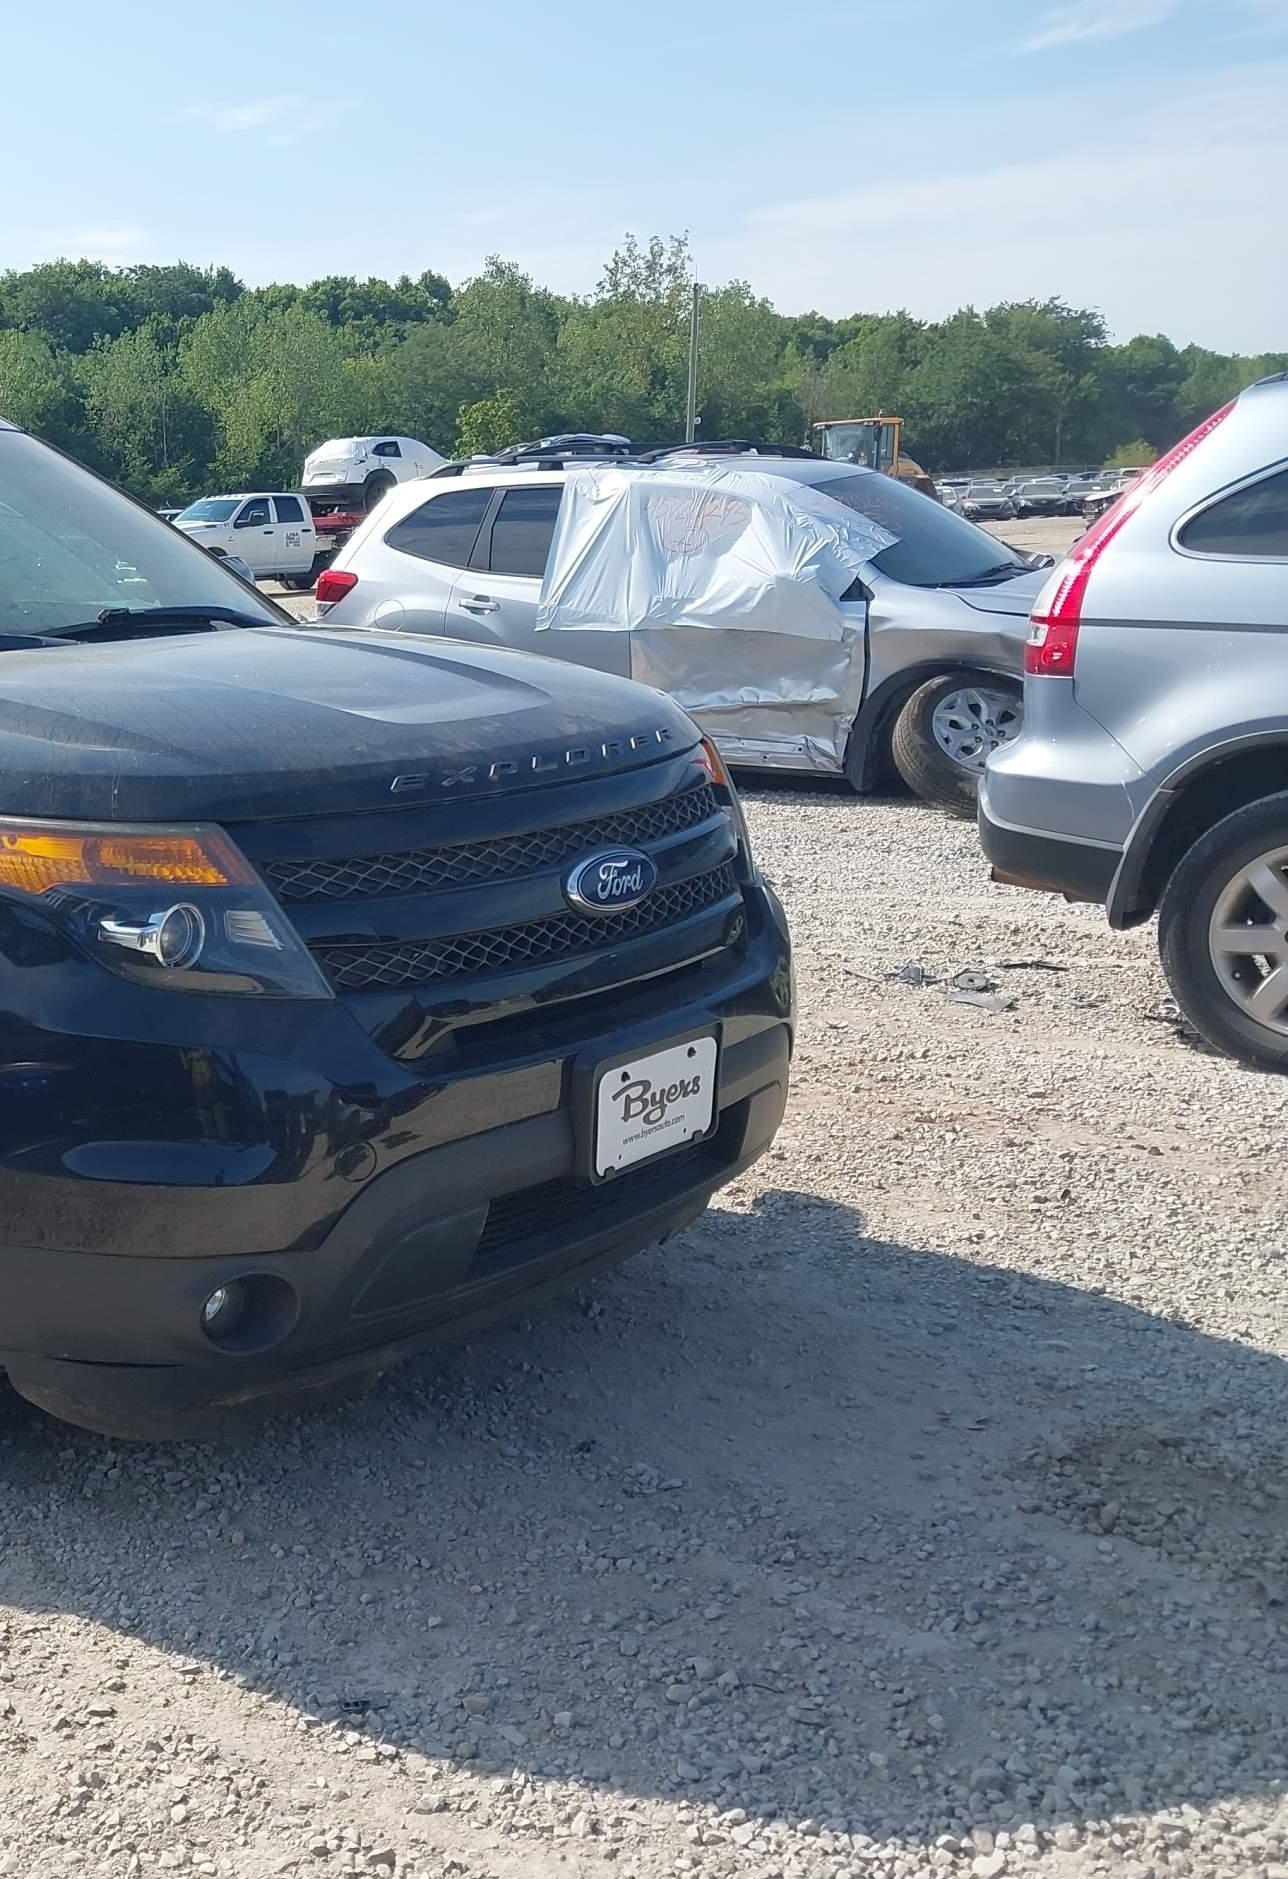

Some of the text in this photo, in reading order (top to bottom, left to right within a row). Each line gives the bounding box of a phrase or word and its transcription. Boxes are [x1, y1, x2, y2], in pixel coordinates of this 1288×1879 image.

[390, 727, 674, 793] EXPLORER
[597, 859, 644, 901] Ford
[611, 1075, 701, 1126] Byers
[622, 1113, 686, 1146] www.byersauto.com
